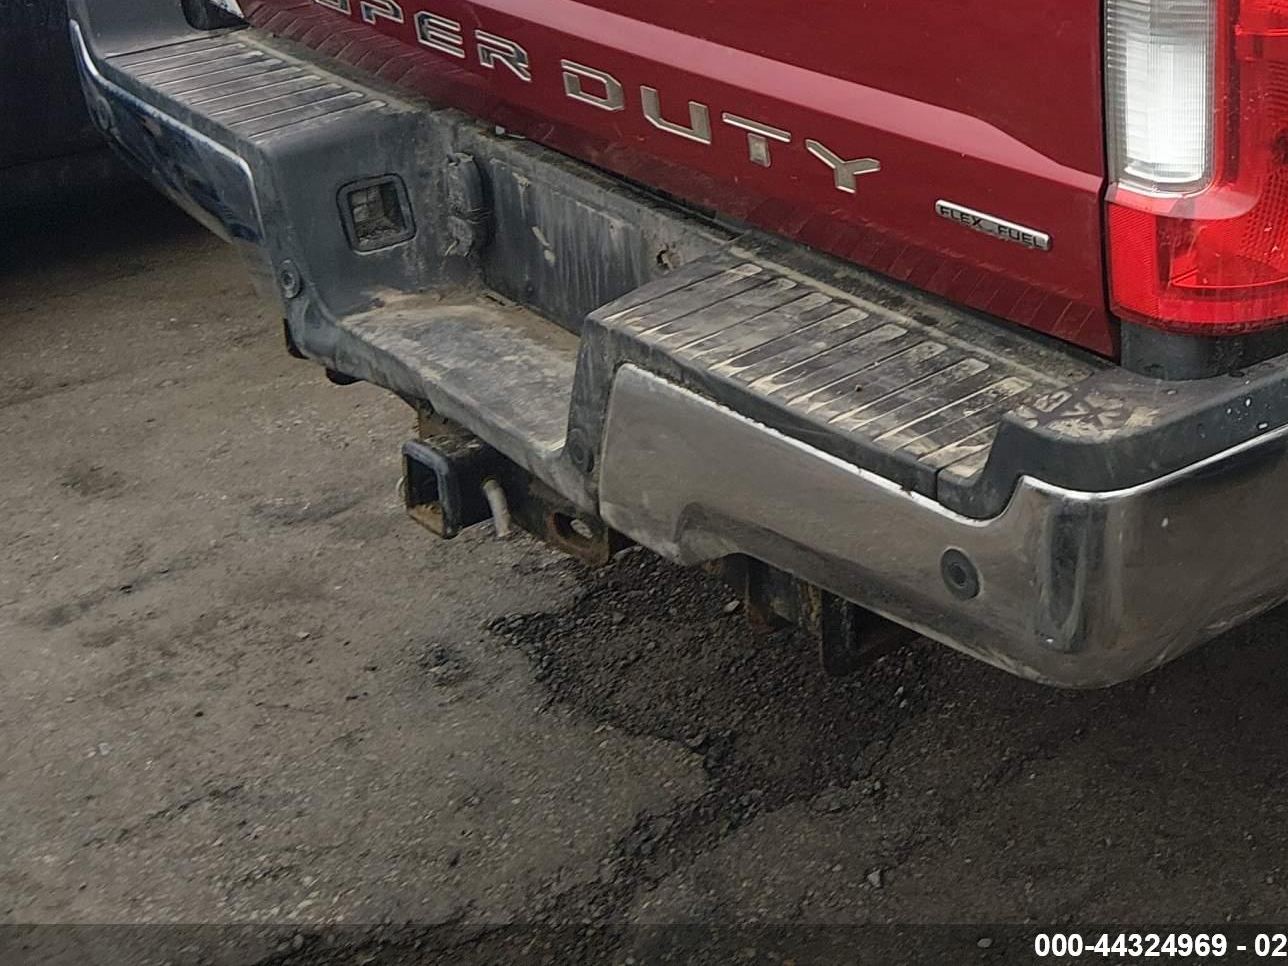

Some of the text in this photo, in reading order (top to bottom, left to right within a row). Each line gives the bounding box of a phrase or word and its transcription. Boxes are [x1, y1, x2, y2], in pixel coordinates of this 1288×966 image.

[560, 58, 881, 194] DUTY
[938, 204, 1045, 249] FLEX FUEL
